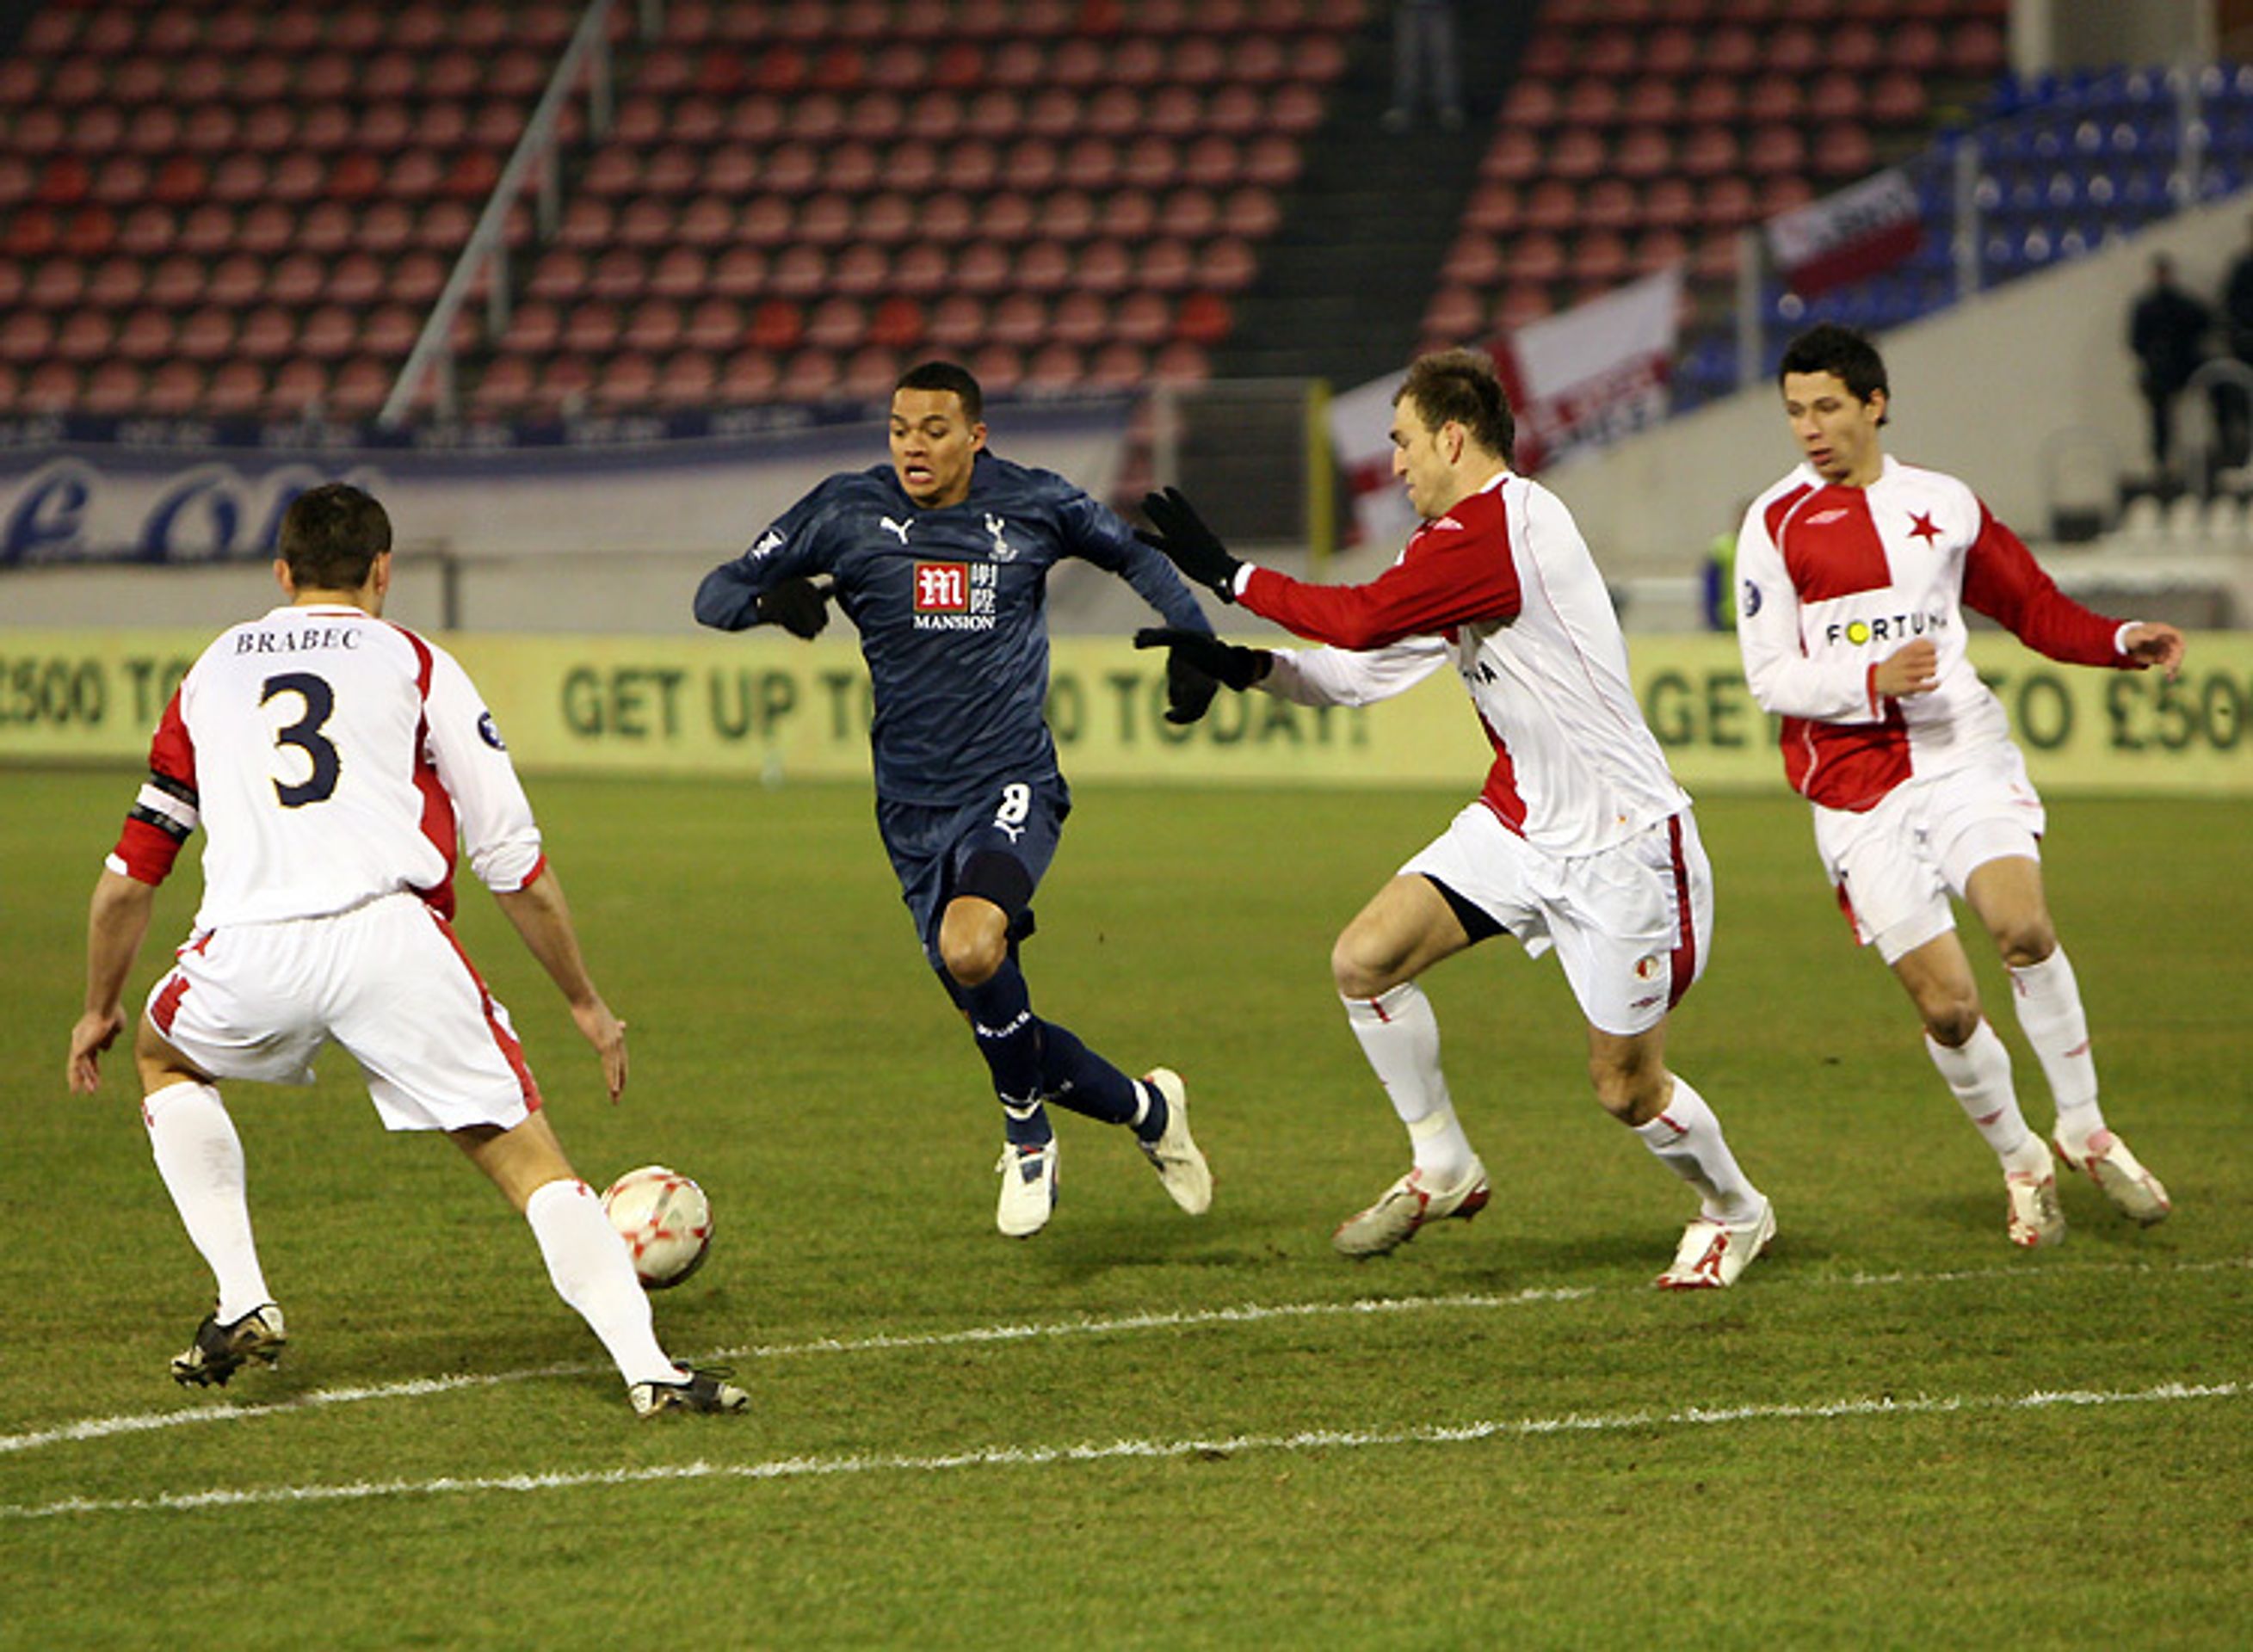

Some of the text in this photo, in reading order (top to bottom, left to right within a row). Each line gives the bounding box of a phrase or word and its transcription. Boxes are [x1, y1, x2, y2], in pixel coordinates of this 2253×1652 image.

[235, 627, 361, 655] BRABEC
[913, 615, 997, 630] MANSION
[561, 666, 688, 738] GET
[707, 667, 799, 741] UP
[257, 671, 343, 809] 3
[997, 783, 1032, 824] 8
